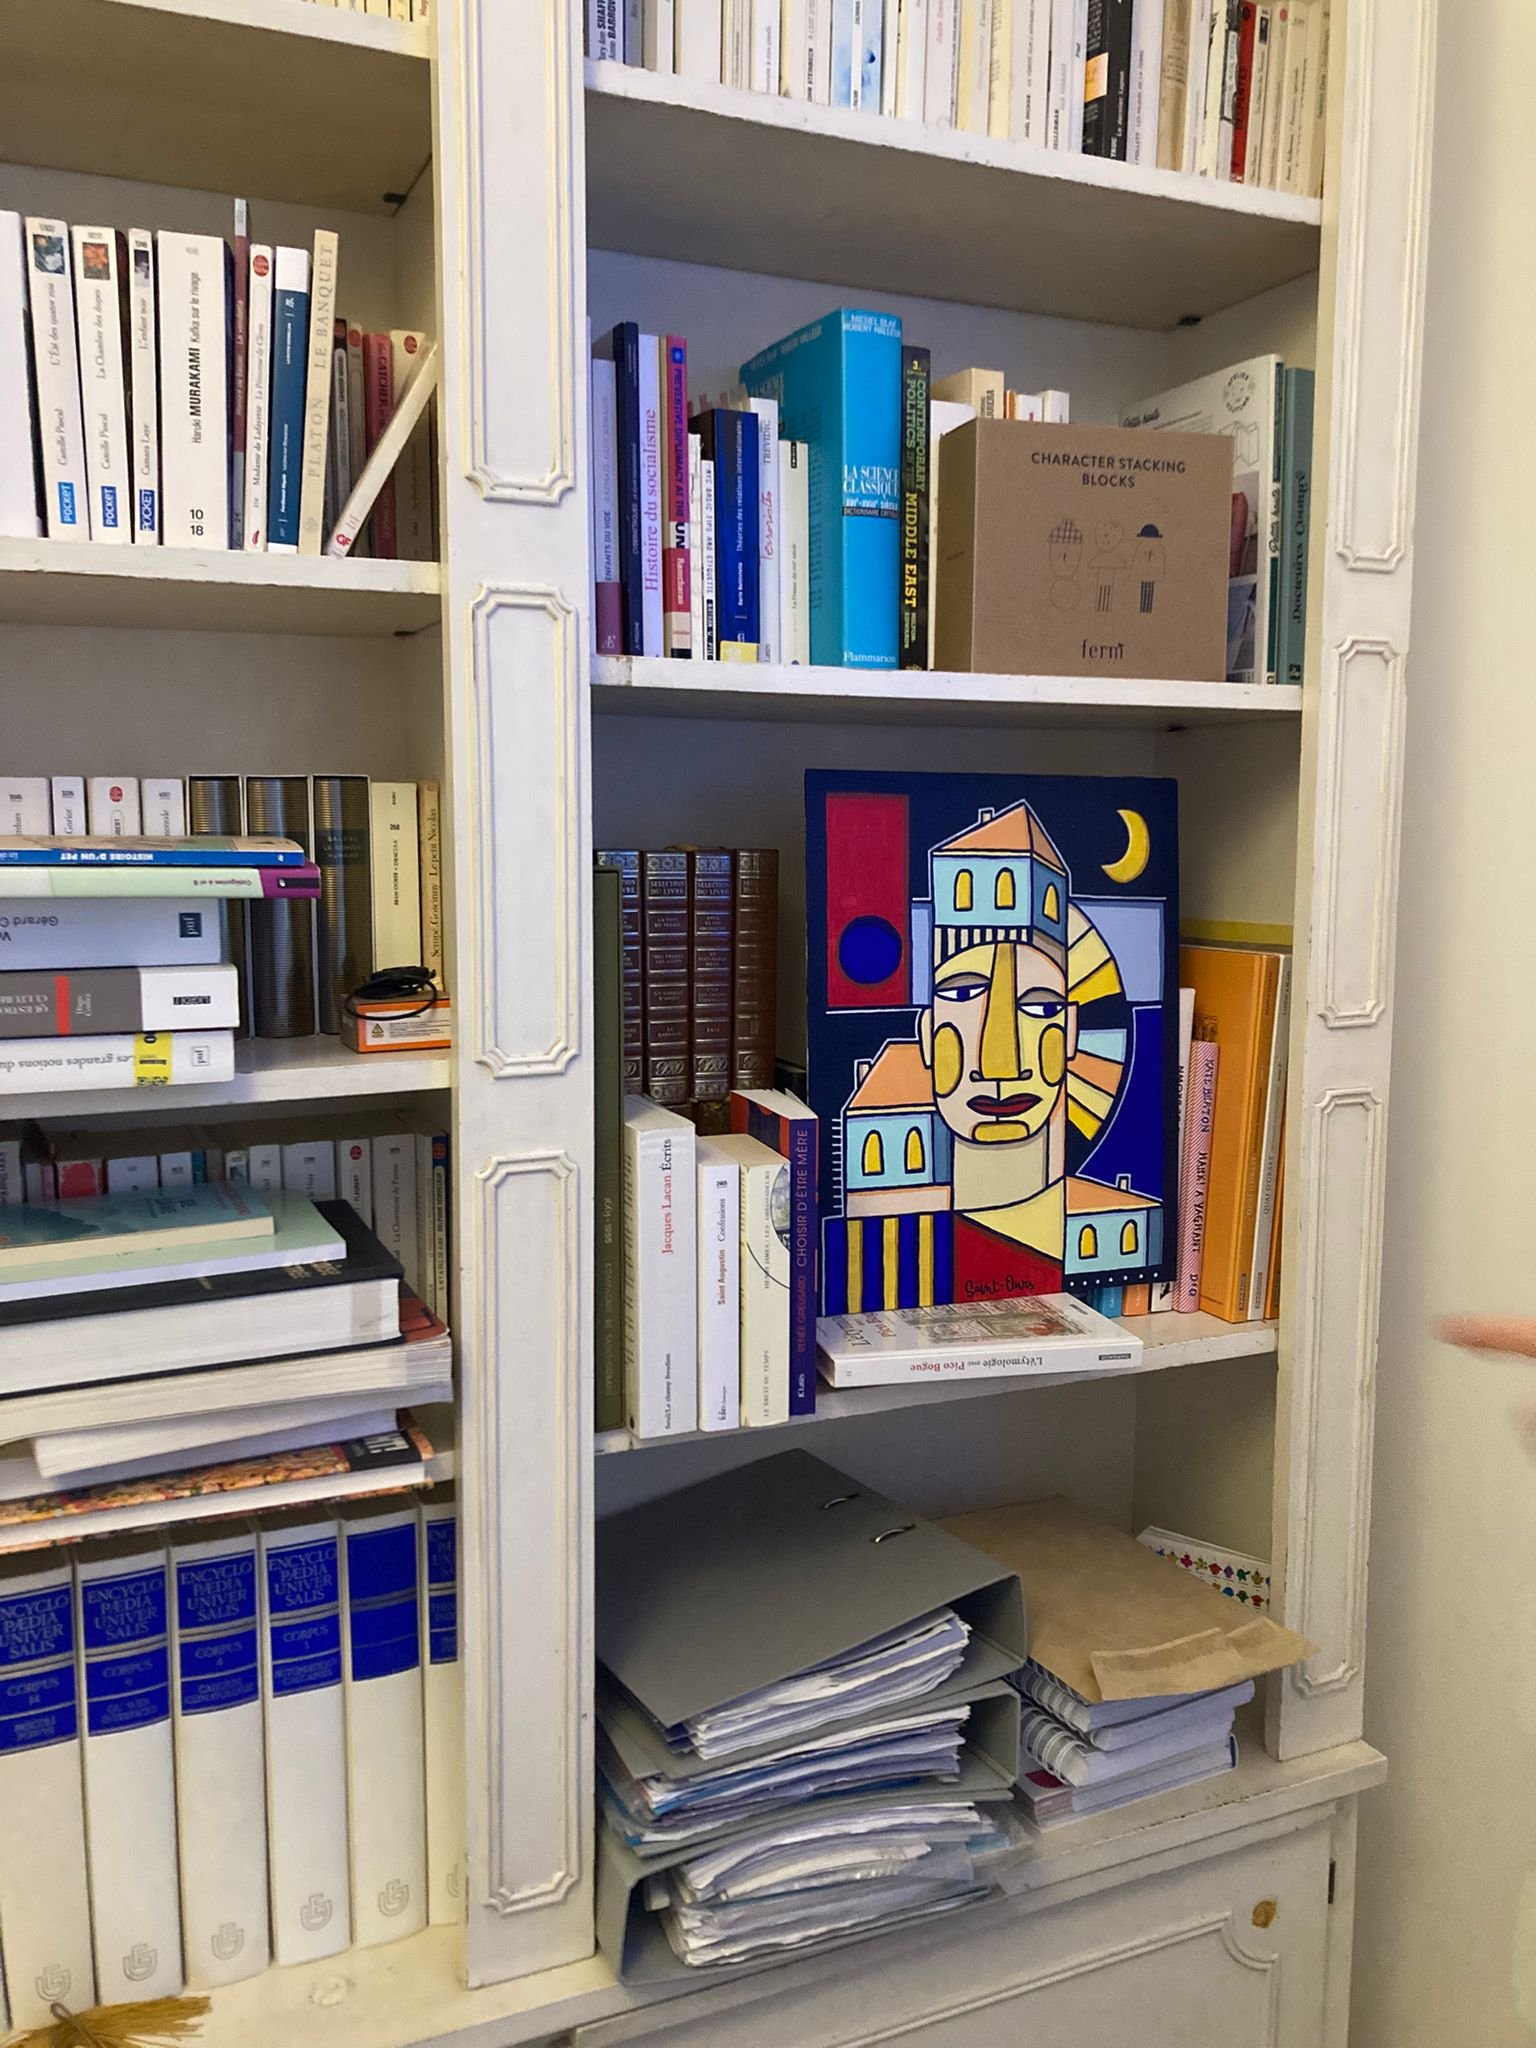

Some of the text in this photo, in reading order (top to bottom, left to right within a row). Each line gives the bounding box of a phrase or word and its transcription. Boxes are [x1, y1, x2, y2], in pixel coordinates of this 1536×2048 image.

[189, 273, 200, 296] rivage
[191, 306, 200, 319] sur
[851, 314, 878, 324] MICHEL
[189, 321, 200, 343] Kafka
[308, 245, 333, 478] PLATON LE BANQUET
[96, 368, 106, 379] La
[188, 348, 201, 417] MURAKAMI
[378, 357, 388, 407] CATCHER
[255, 391, 263, 400] La
[674, 369, 684, 426] PREVENTIVE
[55, 409, 65, 434] Pascal
[253, 406, 263, 440] Lafayette
[906, 379, 917, 448] POLITICS
[98, 414, 108, 438] Pascal
[190, 419, 202, 443] Haruki
[915, 379, 927, 492] CONTEMPORARY
[58, 436, 67, 466] Camille
[100, 440, 110, 470] Camille
[253, 443, 262, 452] de
[673, 428, 684, 483] DIPLOMACY
[735, 421, 744, 473] internationales
[141, 446, 150, 475] Camara
[252, 454, 261, 485] Madame
[843, 464, 899, 480] LA SCIENCE
[1031, 452, 1186, 473] CHARACTER STACKING
[675, 485, 685, 499] AT
[736, 476, 744, 506] relations
[1082, 473, 1135, 488] BLOCKS
[140, 489, 154, 531] POCKET
[642, 410, 659, 591] Histoire du socialisme
[675, 501, 685, 517] THE
[189, 509, 204, 520] 10
[904, 492, 917, 558] MIDDLE
[189, 524, 204, 536] 18
[675, 522, 686, 549] UN
[736, 522, 744, 552] Théories
[603, 511, 612, 581] ENFANTS DU VIDE
[904, 564, 917, 607] EAST
[844, 652, 896, 664] Flammarion
[1082, 638, 1126, 659] ferm
[428, 808, 439, 876] Le petit Nicolas
[60, 852, 154, 862] HISTOIRE D'UN PET
[14, 915, 58, 928] Gérard
[18, 1060, 63, 1069] notions
[67, 1054, 113, 1067] grandes
[1204, 1058, 1215, 1085] KATE
[1201, 1087, 1214, 1132] BEATON
[659, 1138, 672, 1171] Écrits
[391, 1163, 399, 1184] Parme
[1196, 1152, 1208, 1185] HARK!
[392, 1185, 399, 1193] de
[661, 1175, 672, 1209] Lacan
[1245, 1156, 1257, 1216] QUAI D'ORSAY
[1262, 1155, 1275, 1215] QUAI D'ORSAY
[392, 1232, 400, 1243] La
[661, 1212, 675, 1254] Jacques
[1192, 1202, 1203, 1253] VAGRANT
[793, 1129, 808, 1353] RENÉE GREUSARD CHOISIR D'ÊTRE MÈRE
[716, 1198, 727, 1421] folio Saint Augustin Confessions
[910, 1361, 941, 1375] Bogue
[942, 1360, 965, 1373] Pico
[982, 1356, 1043, 1370] L'étymologie
[269, 1548, 338, 1571] ENCYCLO
[181, 1562, 252, 1585] ENCYCLO
[281, 1564, 328, 1582] PÆDIA
[87, 1578, 163, 1604] ENCYCLO
[193, 1578, 242, 1597] PÆDIA
[275, 1574, 333, 1596] UNIVER
[101, 1596, 152, 1614] PÆDIA
[187, 1588, 247, 1610] UNIVER
[286, 1588, 325, 1607] SALIS
[3, 1612, 58, 1633] PÆDIA
[95, 1606, 158, 1629] UNIVER
[198, 1604, 239, 1622] SALIS
[0, 1623, 64, 1647] UNIVER
[105, 1622, 149, 1641] SALIS
[283, 1625, 328, 1642] CORPUS
[9, 1639, 56, 1659] SALIS
[195, 1641, 243, 1659] CORPUS
[103, 1659, 152, 1679] CORPUS
[7, 1677, 60, 1697] CORPUS
